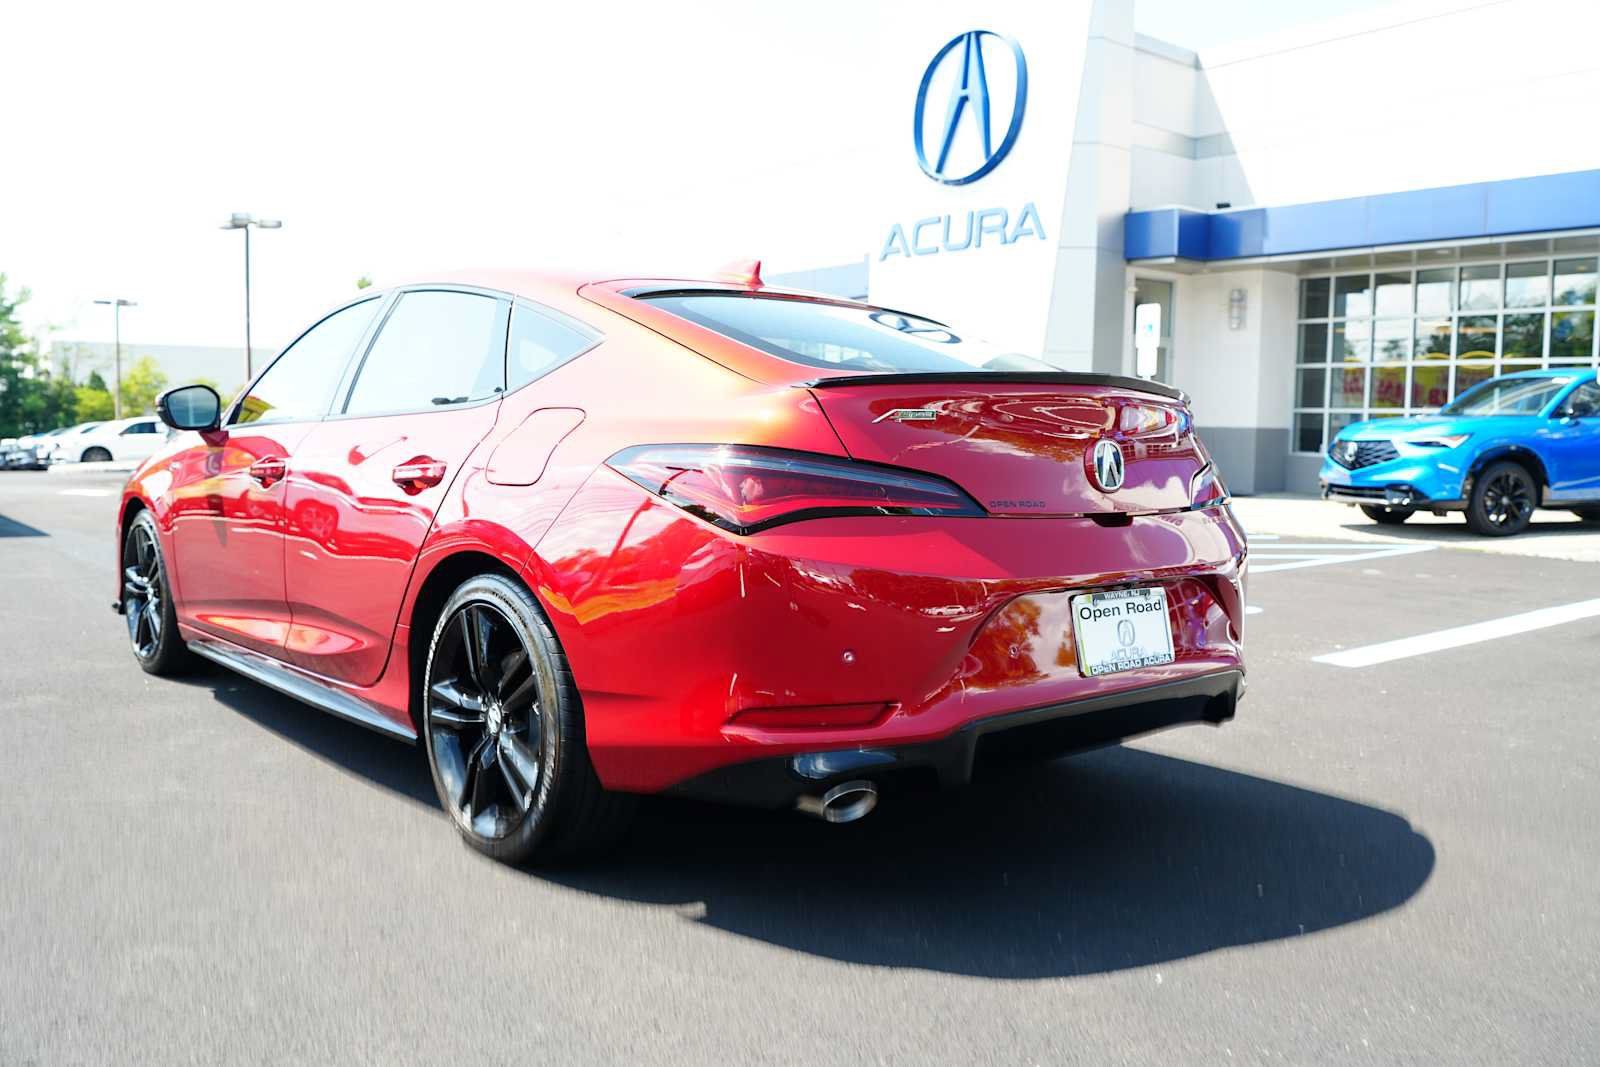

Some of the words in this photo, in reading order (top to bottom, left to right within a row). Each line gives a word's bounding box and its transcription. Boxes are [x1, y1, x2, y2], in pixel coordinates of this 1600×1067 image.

[880, 202, 1046, 261] ACURA
[990, 500, 1017, 508] OPEN
[1018, 500, 1046, 508] ROAD
[1080, 606, 1120, 621] Open
[1126, 600, 1162, 614] Road
[1092, 664, 1117, 675] OPEN
[1117, 659, 1142, 671] ROAD
[1143, 653, 1171, 667] ACURA
